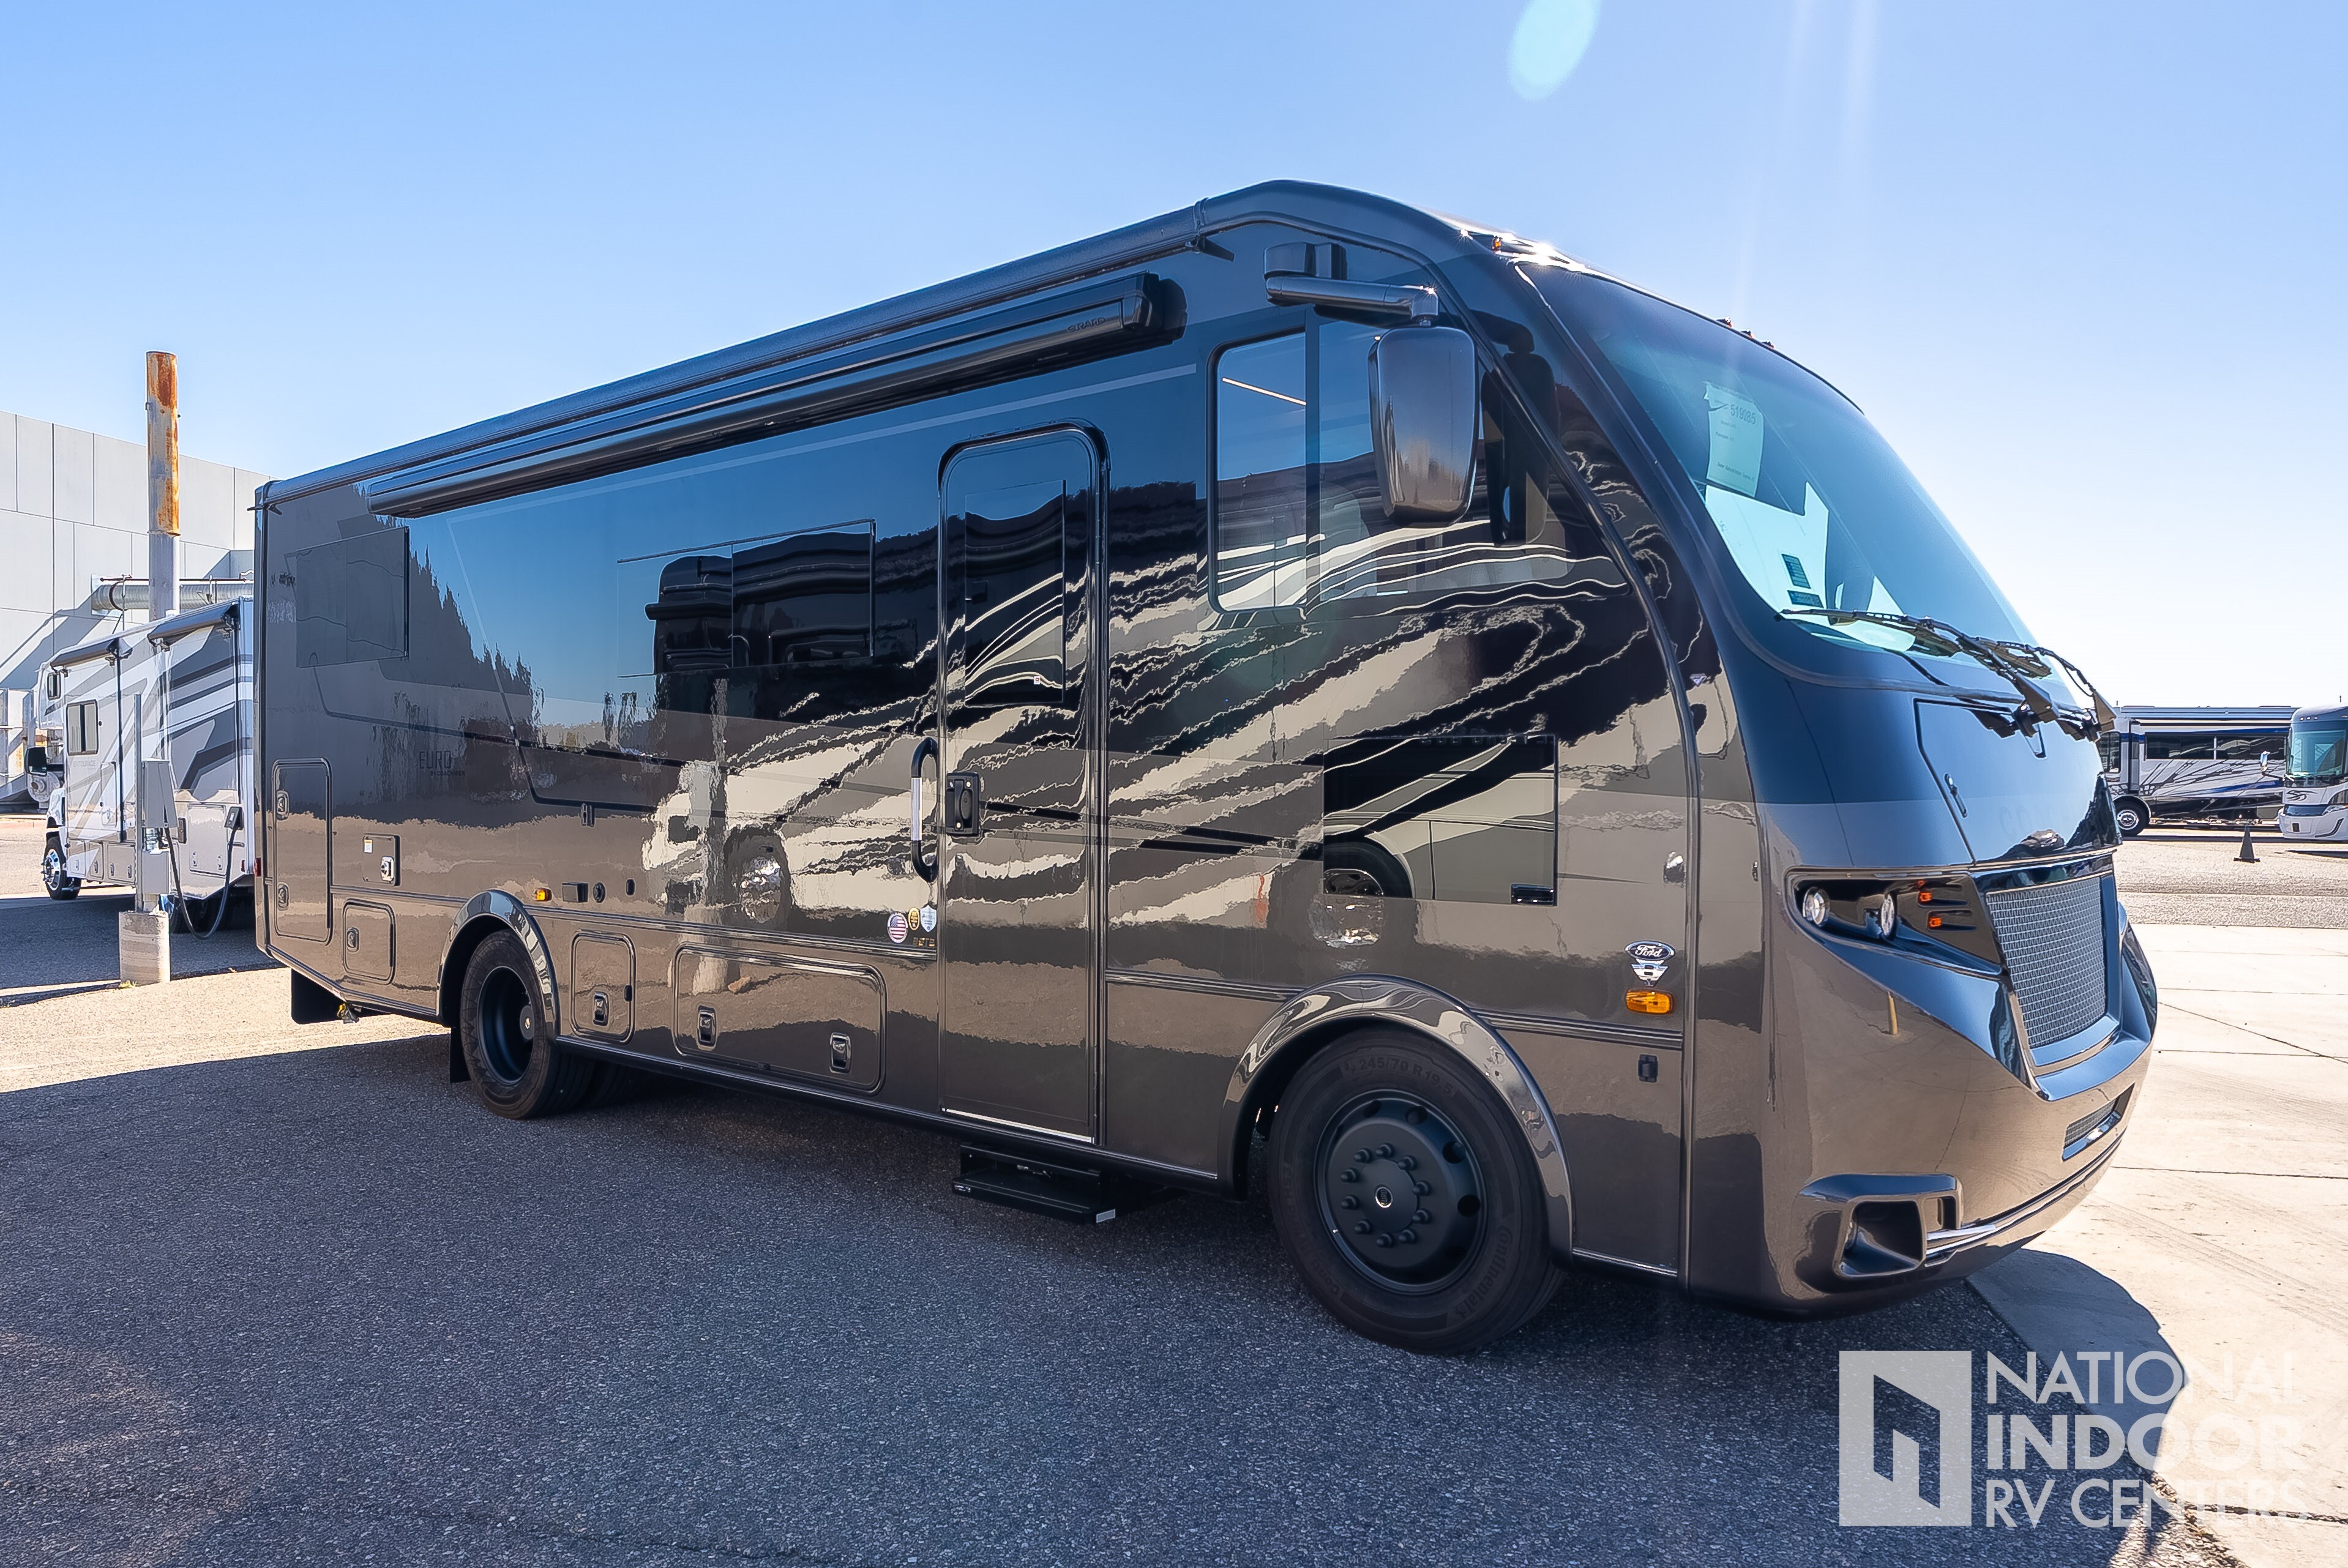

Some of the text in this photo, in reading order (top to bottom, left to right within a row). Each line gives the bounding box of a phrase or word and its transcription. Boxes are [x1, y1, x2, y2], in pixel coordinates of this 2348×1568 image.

[419, 750, 452, 769] EURO
[1635, 944, 1662, 957] Ford
[1359, 1057, 1408, 1072] 245/70
[1462, 1224, 1514, 1313] Continental
